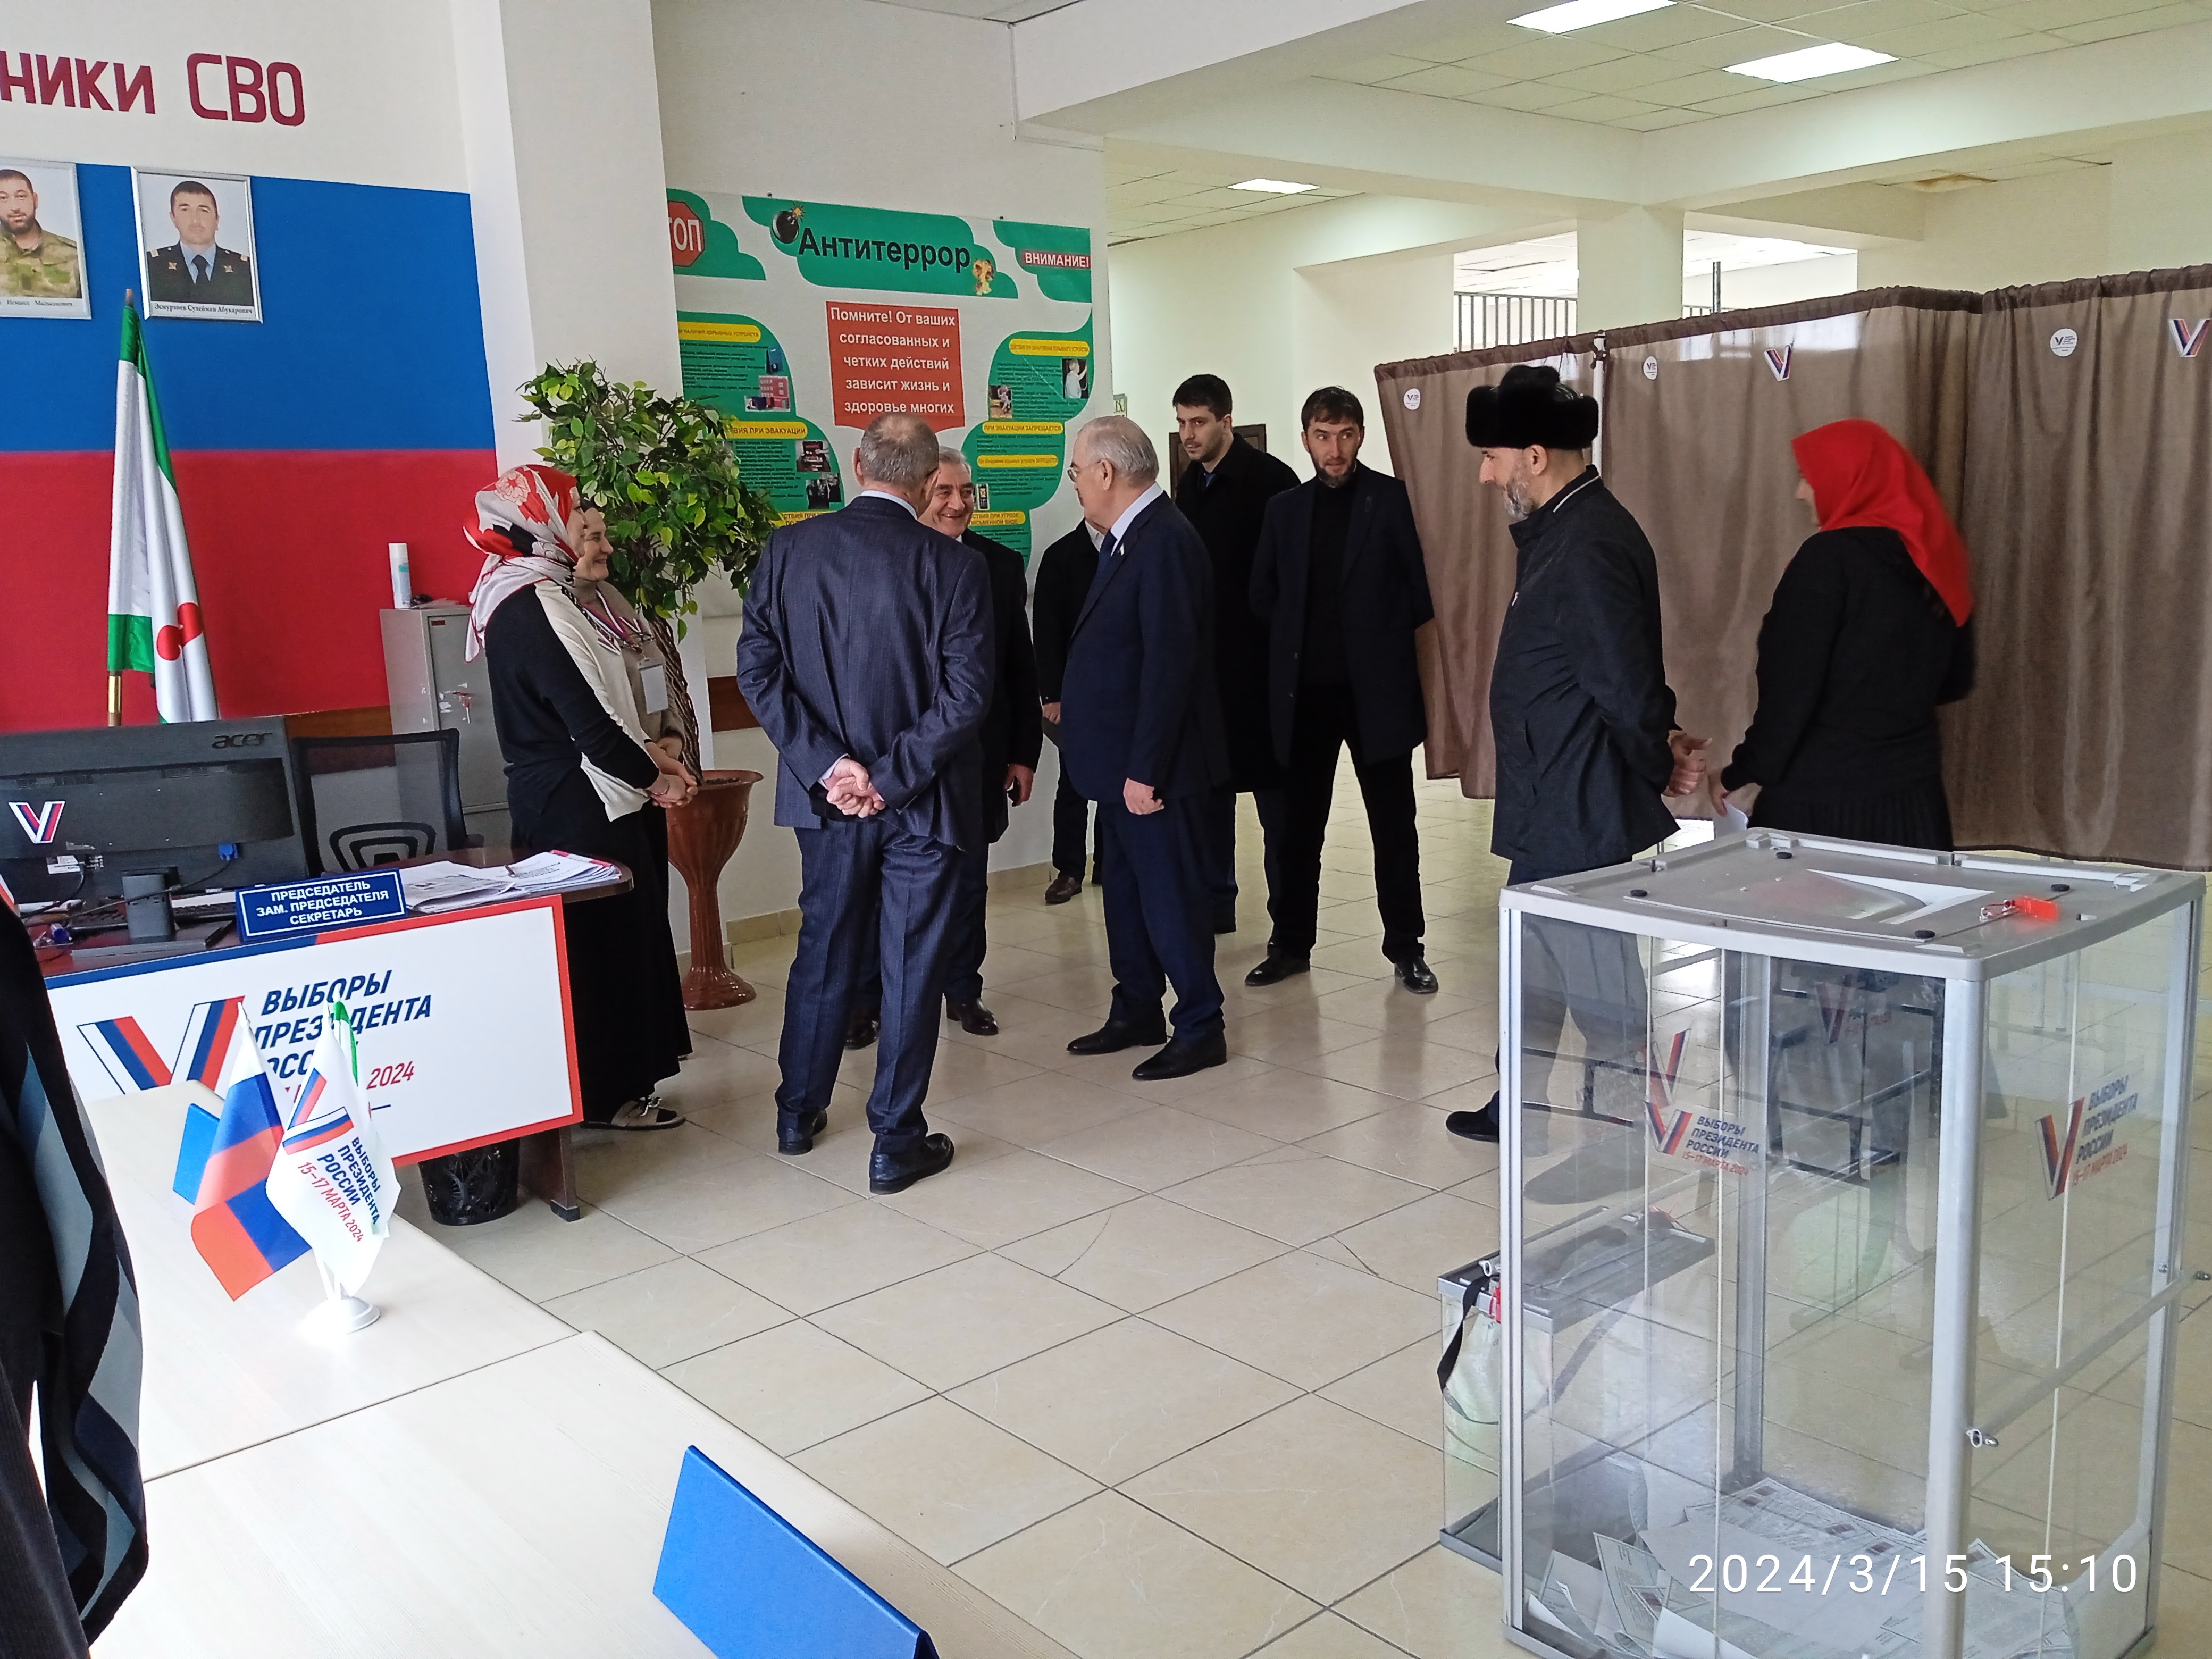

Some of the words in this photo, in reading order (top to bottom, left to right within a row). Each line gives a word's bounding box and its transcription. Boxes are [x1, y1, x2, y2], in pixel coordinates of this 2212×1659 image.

[187, 52, 305, 127] СВО
[798, 227, 971, 274] Антитеррор
[1025, 252, 1090, 268] ВНИМАНИЕ!
[831, 307, 893, 323] Помните!
[895, 311, 912, 324] От
[916, 315, 956, 326] ваших
[839, 333, 939, 348] согласованных
[942, 338, 950, 348] и
[843, 356, 887, 368] четких
[890, 356, 950, 370] действий
[845, 379, 898, 390] зависит
[900, 380, 940, 391] жизнь
[942, 382, 950, 392] и
[844, 401, 907, 415] здоровье
[910, 403, 954, 413] многих
[212, 731, 272, 749] acer
[271, 881, 371, 902] ПРЕДСЕДАТЕЛЬ
[256, 904, 288, 917] ЗАМ.
[291, 890, 389, 912] ПРЕДСЕДАТЕЛЯ
[290, 907, 363, 925] СЕКРЕТАРЬ
[261, 970, 392, 1017] ВЫБОРЫ
[255, 994, 432, 1050] ПРЕЗДЕНТА
[366, 1061, 415, 1090] 2024
[1696, 1116, 1747, 1136] ВЫБОРЫ
[1685, 1139, 1730, 1159] РОССИИ
[1690, 1127, 1759, 1153] ПРЕЗИДЕНТА
[351, 1136, 381, 1193] ВЫБОРЫ
[316, 1153, 361, 1206] РОССИИ
[338, 1144, 380, 1225] ПРЕЗИДЕНТА
[321, 1187, 352, 1221] МАРТА
[345, 1219, 364, 1242] 2024
